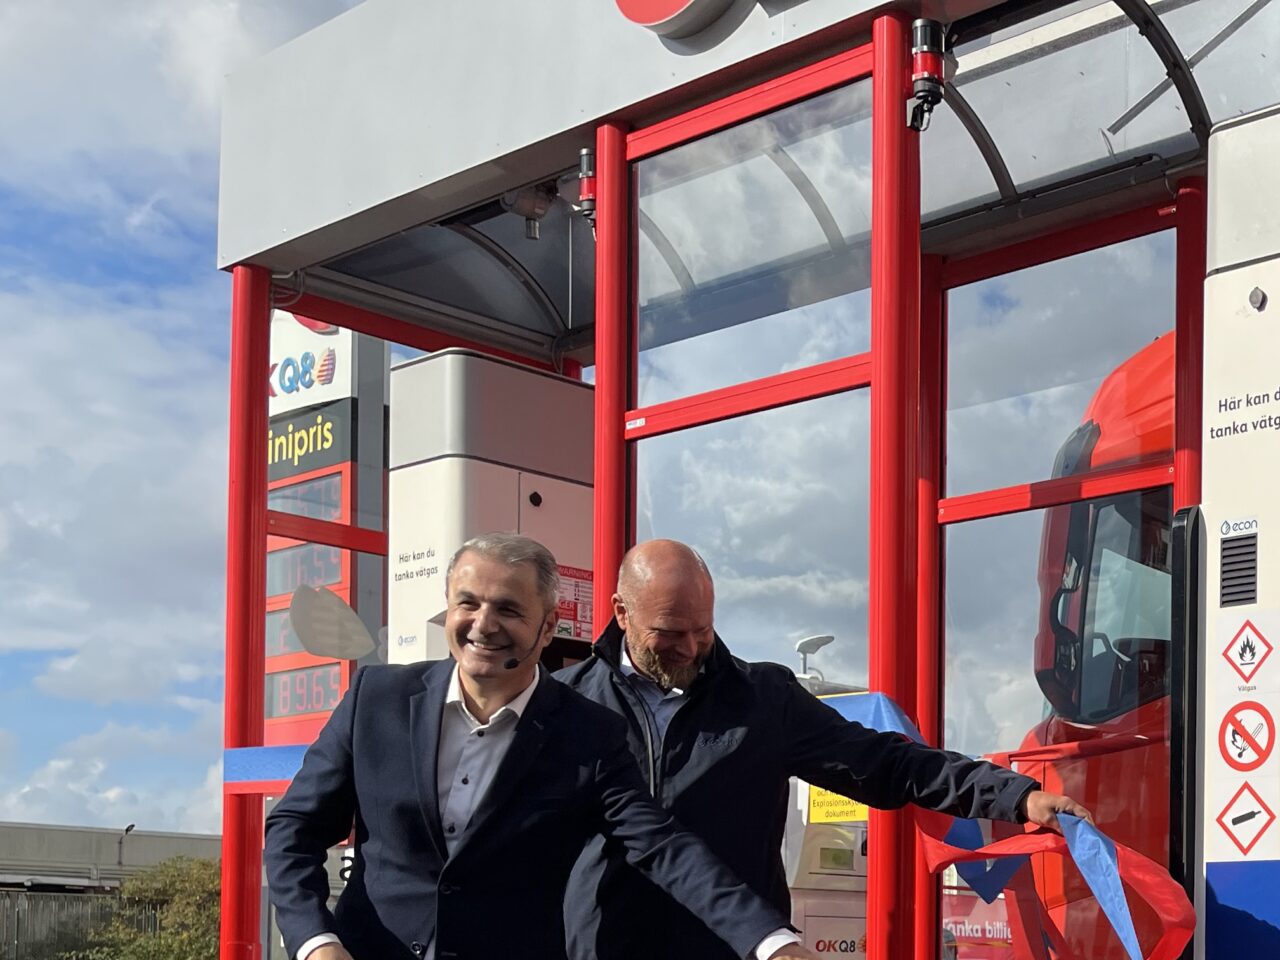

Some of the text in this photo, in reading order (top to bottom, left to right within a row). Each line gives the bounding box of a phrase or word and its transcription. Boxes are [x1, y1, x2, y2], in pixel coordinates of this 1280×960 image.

[1218, 396, 1243, 413] Här
[1246, 391, 1270, 407] kan
[1210, 421, 1248, 439] tanka
[1232, 518, 1258, 532] econ
[399, 547, 435, 564] Här kan du
[395, 566, 438, 581] tanka vätgas
[825, 810, 856, 818] dokument
